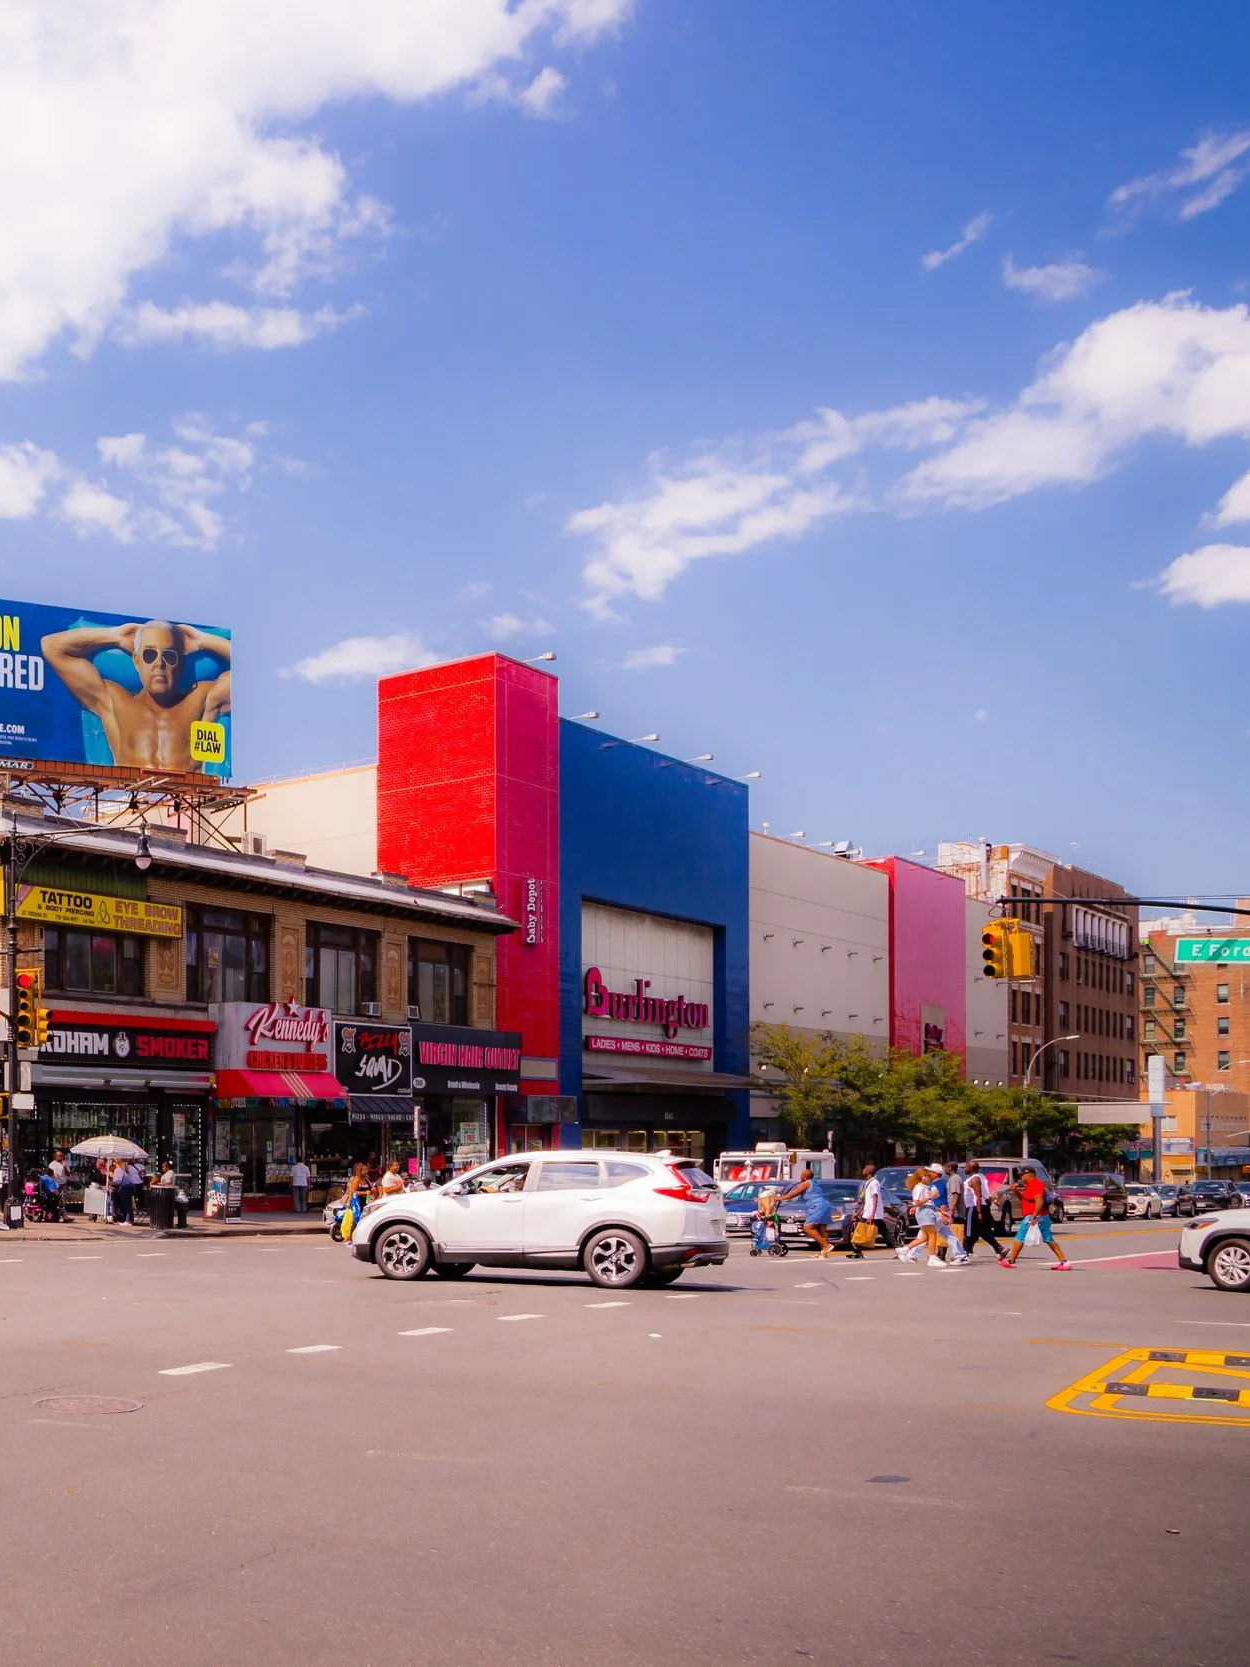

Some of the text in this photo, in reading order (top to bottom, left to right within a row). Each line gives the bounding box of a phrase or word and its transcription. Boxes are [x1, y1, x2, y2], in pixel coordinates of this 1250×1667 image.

[197, 730, 218, 742] DIAL
[194, 740, 221, 754] #LAW
[40, 890, 93, 909] TATTOO
[66, 907, 95, 917] PIERCING
[115, 900, 178, 920] EYE BROW
[526, 878, 537, 943] Baby Depot
[113, 915, 181, 935] THREADING
[1192, 944, 1202, 956] E
[584, 967, 710, 1039] Burlington
[246, 1002, 330, 1052] Kennedy's
[136, 1036, 209, 1059] SMOKER
[419, 1041, 457, 1066] VIRGIN
[458, 1044, 483, 1068] HAIR
[592, 1038, 708, 1058] LADIES MENS KIDS HOME COATS
[249, 1051, 285, 1068] CHICKEN
